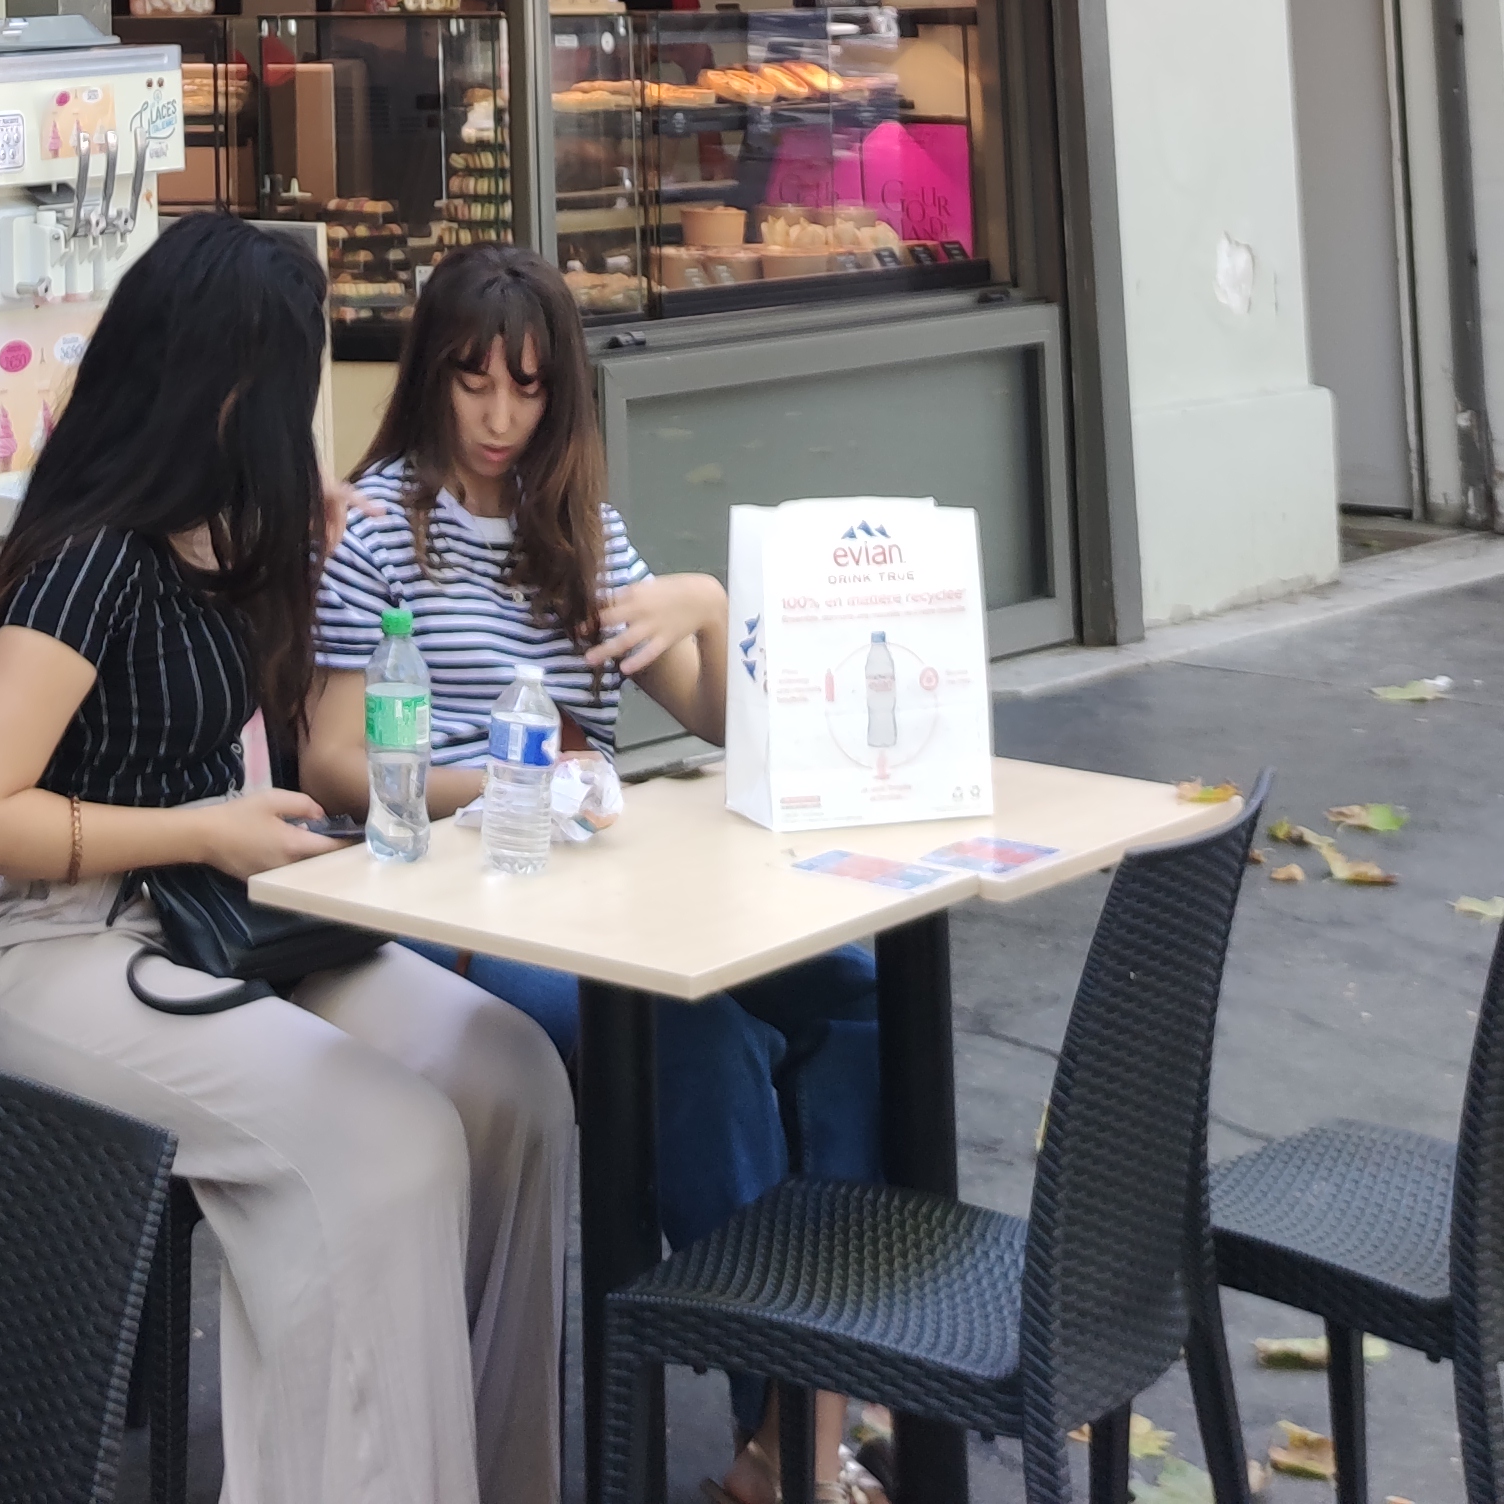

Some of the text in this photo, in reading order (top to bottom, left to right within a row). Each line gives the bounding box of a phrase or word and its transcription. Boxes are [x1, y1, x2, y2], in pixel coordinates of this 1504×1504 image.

[832, 540, 903, 568] evian
[828, 570, 915, 586] DRINK TRUE
